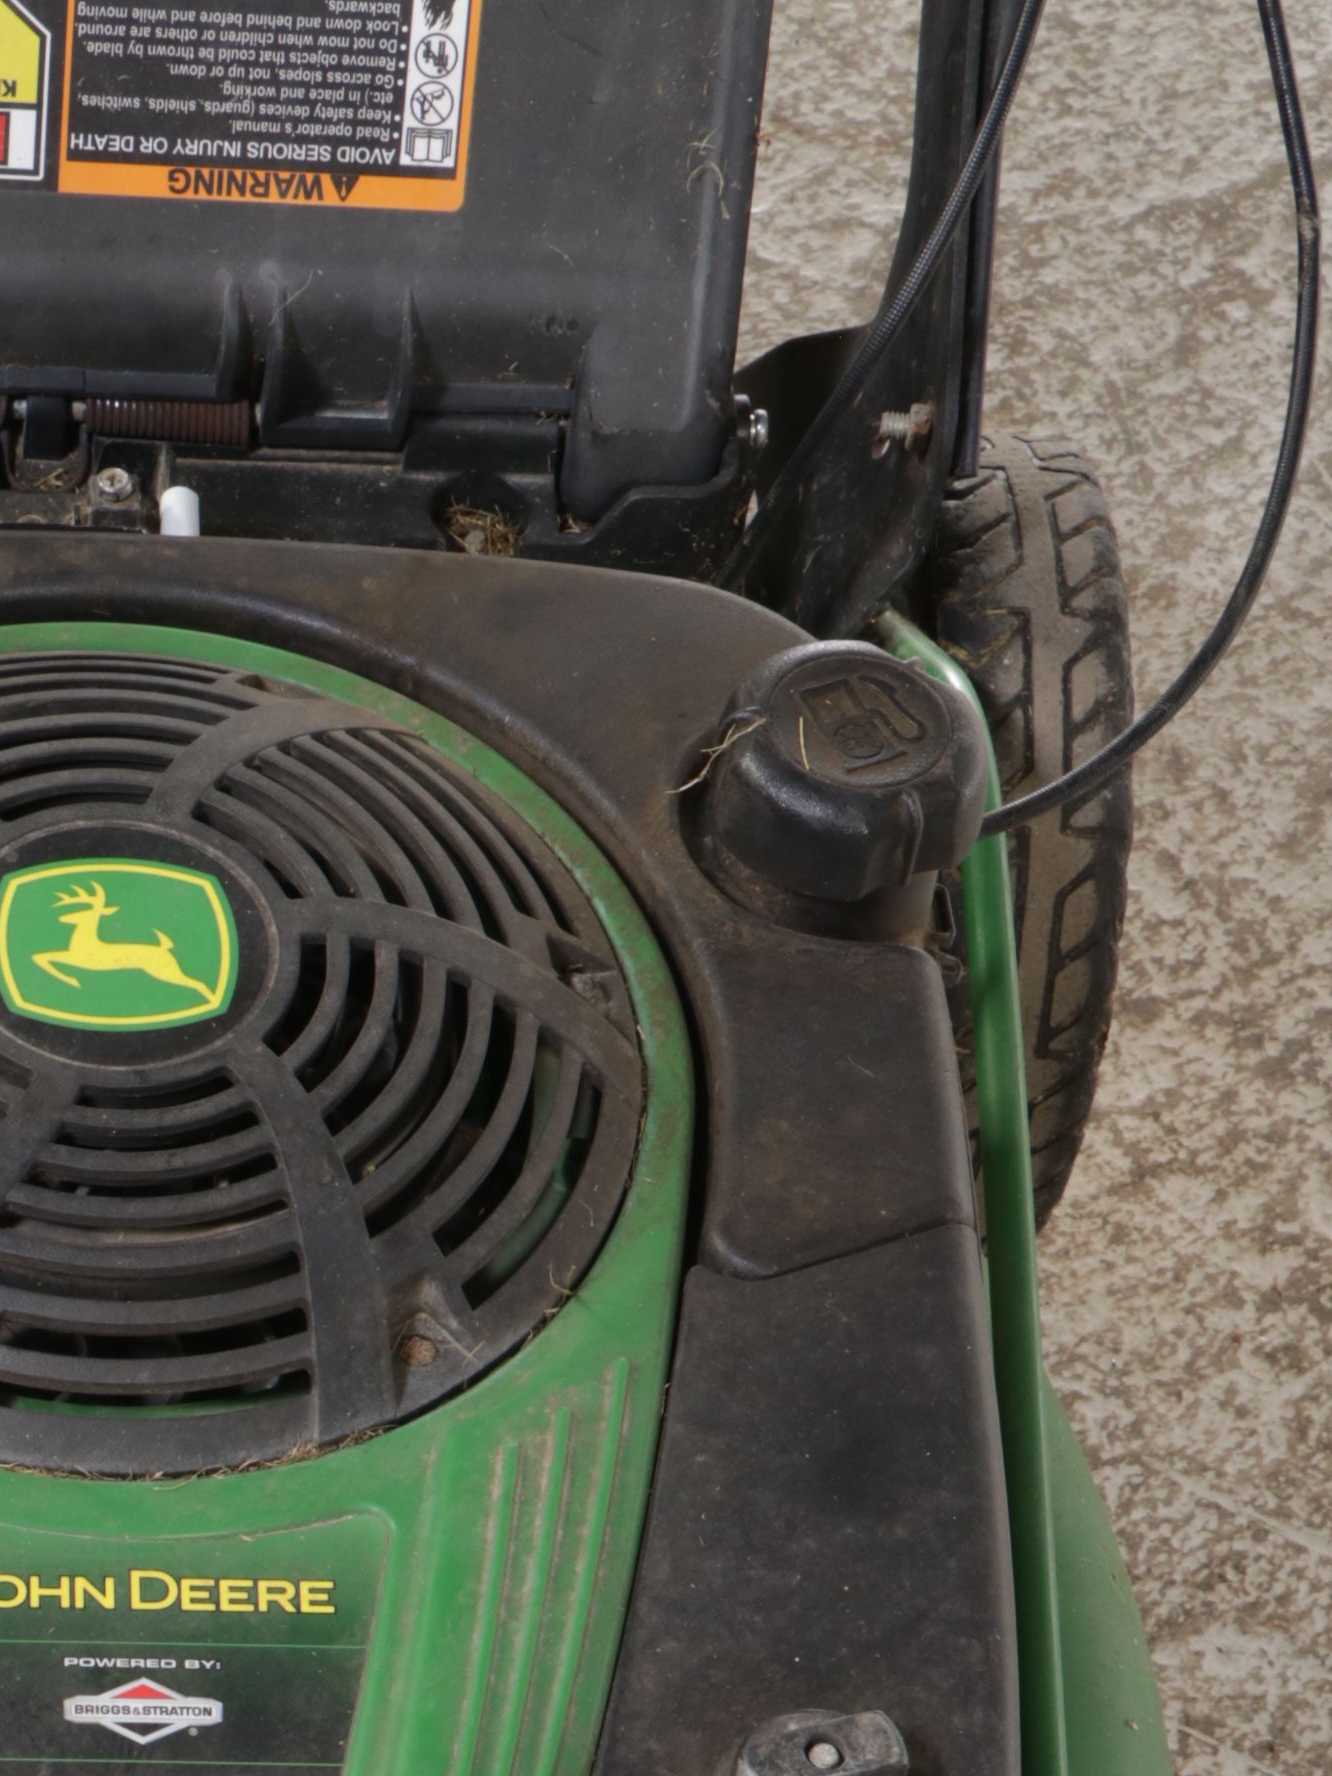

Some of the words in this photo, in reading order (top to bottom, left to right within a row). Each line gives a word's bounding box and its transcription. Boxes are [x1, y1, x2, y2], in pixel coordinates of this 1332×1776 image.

[77, 1, 128, 20] moving
[132, 8, 167, 23] while
[325, 0, 401, 18] backwards.
[171, 10, 196, 24] and
[200, 11, 243, 27] before
[246, 14, 292, 30] behind
[296, 16, 322, 30] and
[75, 23, 126, 37] around.
[130, 26, 151, 37] are
[325, 18, 362, 33] down
[366, 20, 399, 36] Look
[155, 27, 198, 42] others
[201, 30, 216, 41] or
[220, 31, 274, 46] children
[278, 34, 314, 48] when
[317, 36, 350, 47] mow
[84, 41, 123, 57] blade.
[127, 40, 143, 58] by
[353, 37, 375, 50] not
[379, 38, 398, 54] Do
[148, 45, 194, 60] thrown
[198, 47, 215, 62] be
[218, 48, 256, 63] could
[259, 50, 285, 65] that
[289, 50, 338, 67] objects
[342, 54, 396, 71] Remove
[166, 63, 206, 79] down.
[210, 66, 224, 77] or
[228, 64, 245, 78] up
[249, 68, 270, 80] not
[275, 67, 322, 85] slopes,
[327, 72, 372, 84] across
[375, 74, 394, 89] Go
[219, 80, 276, 100] working.
[280, 87, 305, 101] and
[309, 87, 345, 103] place
[365, 90, 393, 105] etc.)
[78, 94, 140, 109] switches,
[349, 91, 361, 105] in
[145, 98, 196, 114] shields,
[201, 99, 255, 116] (guards,
[259, 104, 310, 119] devices
[314, 103, 354, 122] safety
[357, 106, 392, 124] Keep
[228, 119, 281, 134] manual.
[285, 122, 353, 137] operator's
[356, 126, 390, 142] Read
[70, 133, 134, 152] DEATH
[140, 136, 168, 154] OR
[172, 138, 241, 157] INJURY
[246, 141, 332, 162] SERIOUS
[337, 146, 396, 165] AVOID
[167, 168, 325, 201] WARNING
[128, 1568, 337, 1615] DEERE
[63, 1657, 177, 1669] POWERED
[184, 1659, 221, 1670] BY:
